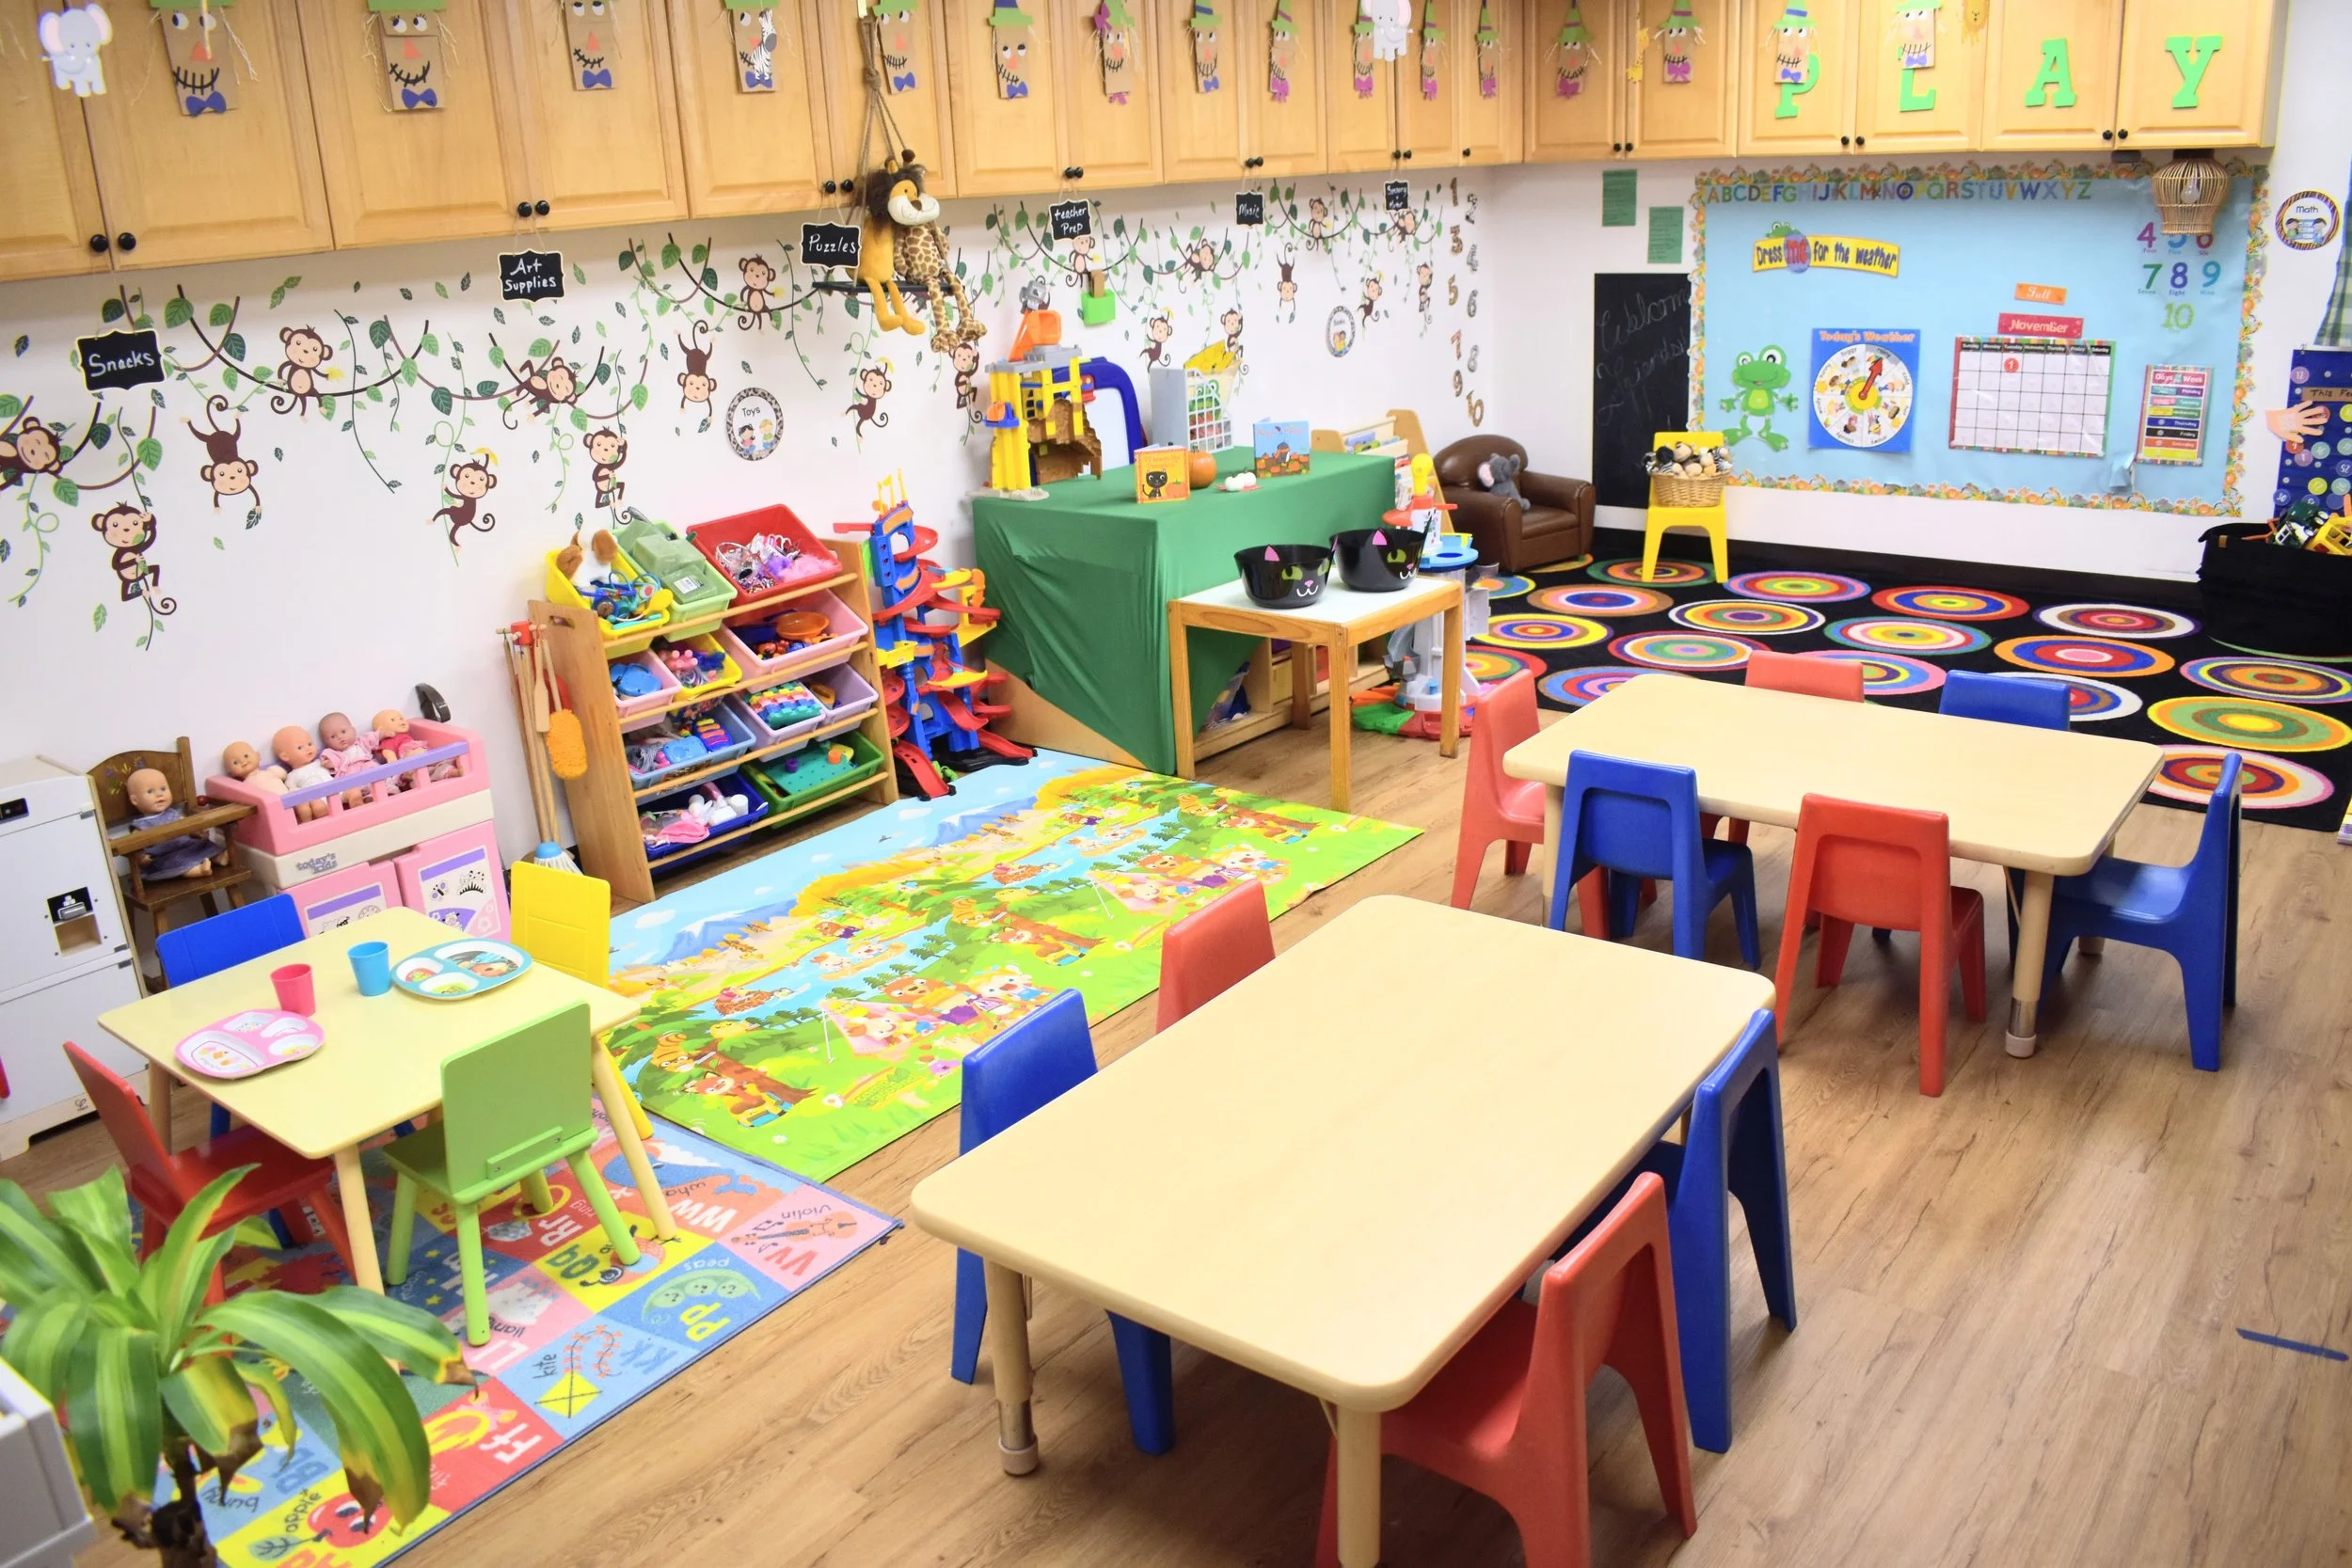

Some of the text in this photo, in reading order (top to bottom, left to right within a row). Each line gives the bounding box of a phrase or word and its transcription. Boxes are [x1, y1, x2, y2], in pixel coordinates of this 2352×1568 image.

[1450, 177, 1458, 207] 1
[1238, 202, 1260, 219] Music
[1465, 193, 1477, 225] 2
[808, 233, 857, 254] Puzzles
[1450, 225, 1464, 254] 3
[2137, 222, 2157, 249] 4
[509, 257, 543, 277] Art
[1466, 244, 1478, 273] 4
[1756, 239, 1898, 270] Dress me for the weather
[503, 276, 557, 294] Supplies
[2142, 261, 2221, 290] 7 8 9
[1448, 274, 1459, 307] 5
[1467, 289, 1479, 318] 6
[2026, 285, 2052, 300] Fall
[1597, 288, 1688, 352] Welcom
[2009, 318, 2070, 334] November
[2162, 302, 2196, 330] 10
[1451, 329, 1462, 360] 7
[1819, 329, 1915, 344] Today's Weather
[88, 350, 155, 378] Snacks
[1467, 344, 1479, 373] 8
[2008, 360, 2015, 370] 1
[1453, 369, 1463, 397] 9
[2311, 388, 2333, 397] This
[741, 406, 761, 417] Toys
[1466, 389, 1484, 426] 10
[664, 1180, 707, 1198] wha
[539, 1213, 584, 1247] Rr
[669, 1197, 739, 1234] Ww
[682, 1256, 731, 1272] peas
[763, 1245, 820, 1277] Vv
[488, 1316, 527, 1338] llam
[679, 1301, 732, 1343] Pp
[532, 1353, 558, 1381] kite
[619, 1338, 678, 1375] Kk
[478, 1422, 544, 1465] Ff
[284, 1490, 323, 1535] apple
